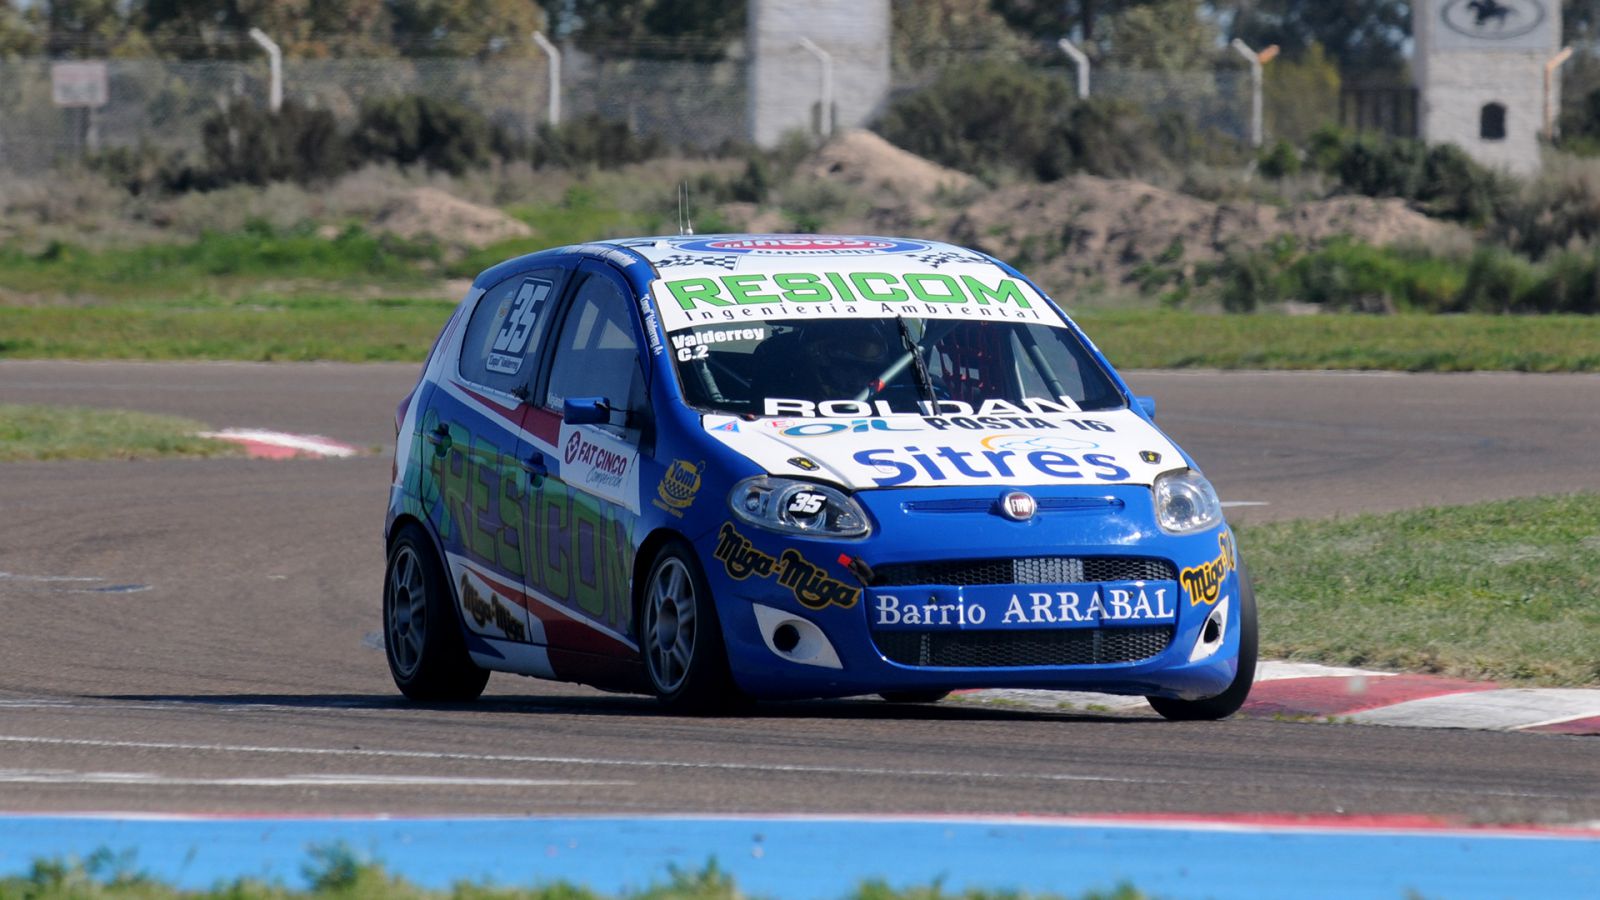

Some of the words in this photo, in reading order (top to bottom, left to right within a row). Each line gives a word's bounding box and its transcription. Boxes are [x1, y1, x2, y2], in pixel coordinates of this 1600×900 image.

[665, 272, 1032, 310] RESICOM
[493, 283, 551, 353] 35
[684, 302, 857, 321] Ingenieria
[881, 301, 1040, 320] Ambiental
[672, 328, 764, 349] Valderrey
[677, 345, 709, 362] C.2
[763, 395, 1084, 418] ROLDAN
[923, 416, 1060, 431] POSTA
[1062, 418, 1116, 433] 16
[577, 441, 599, 466] FAT
[595, 448, 628, 477] CINCO
[853, 445, 1131, 486] Sitres
[671, 460, 697, 488] Yomi
[788, 492, 827, 514] 35
[713, 521, 861, 609] Miga-Miga
[875, 595, 986, 625] Barrio
[1001, 589, 1175, 623] ARRABAL
